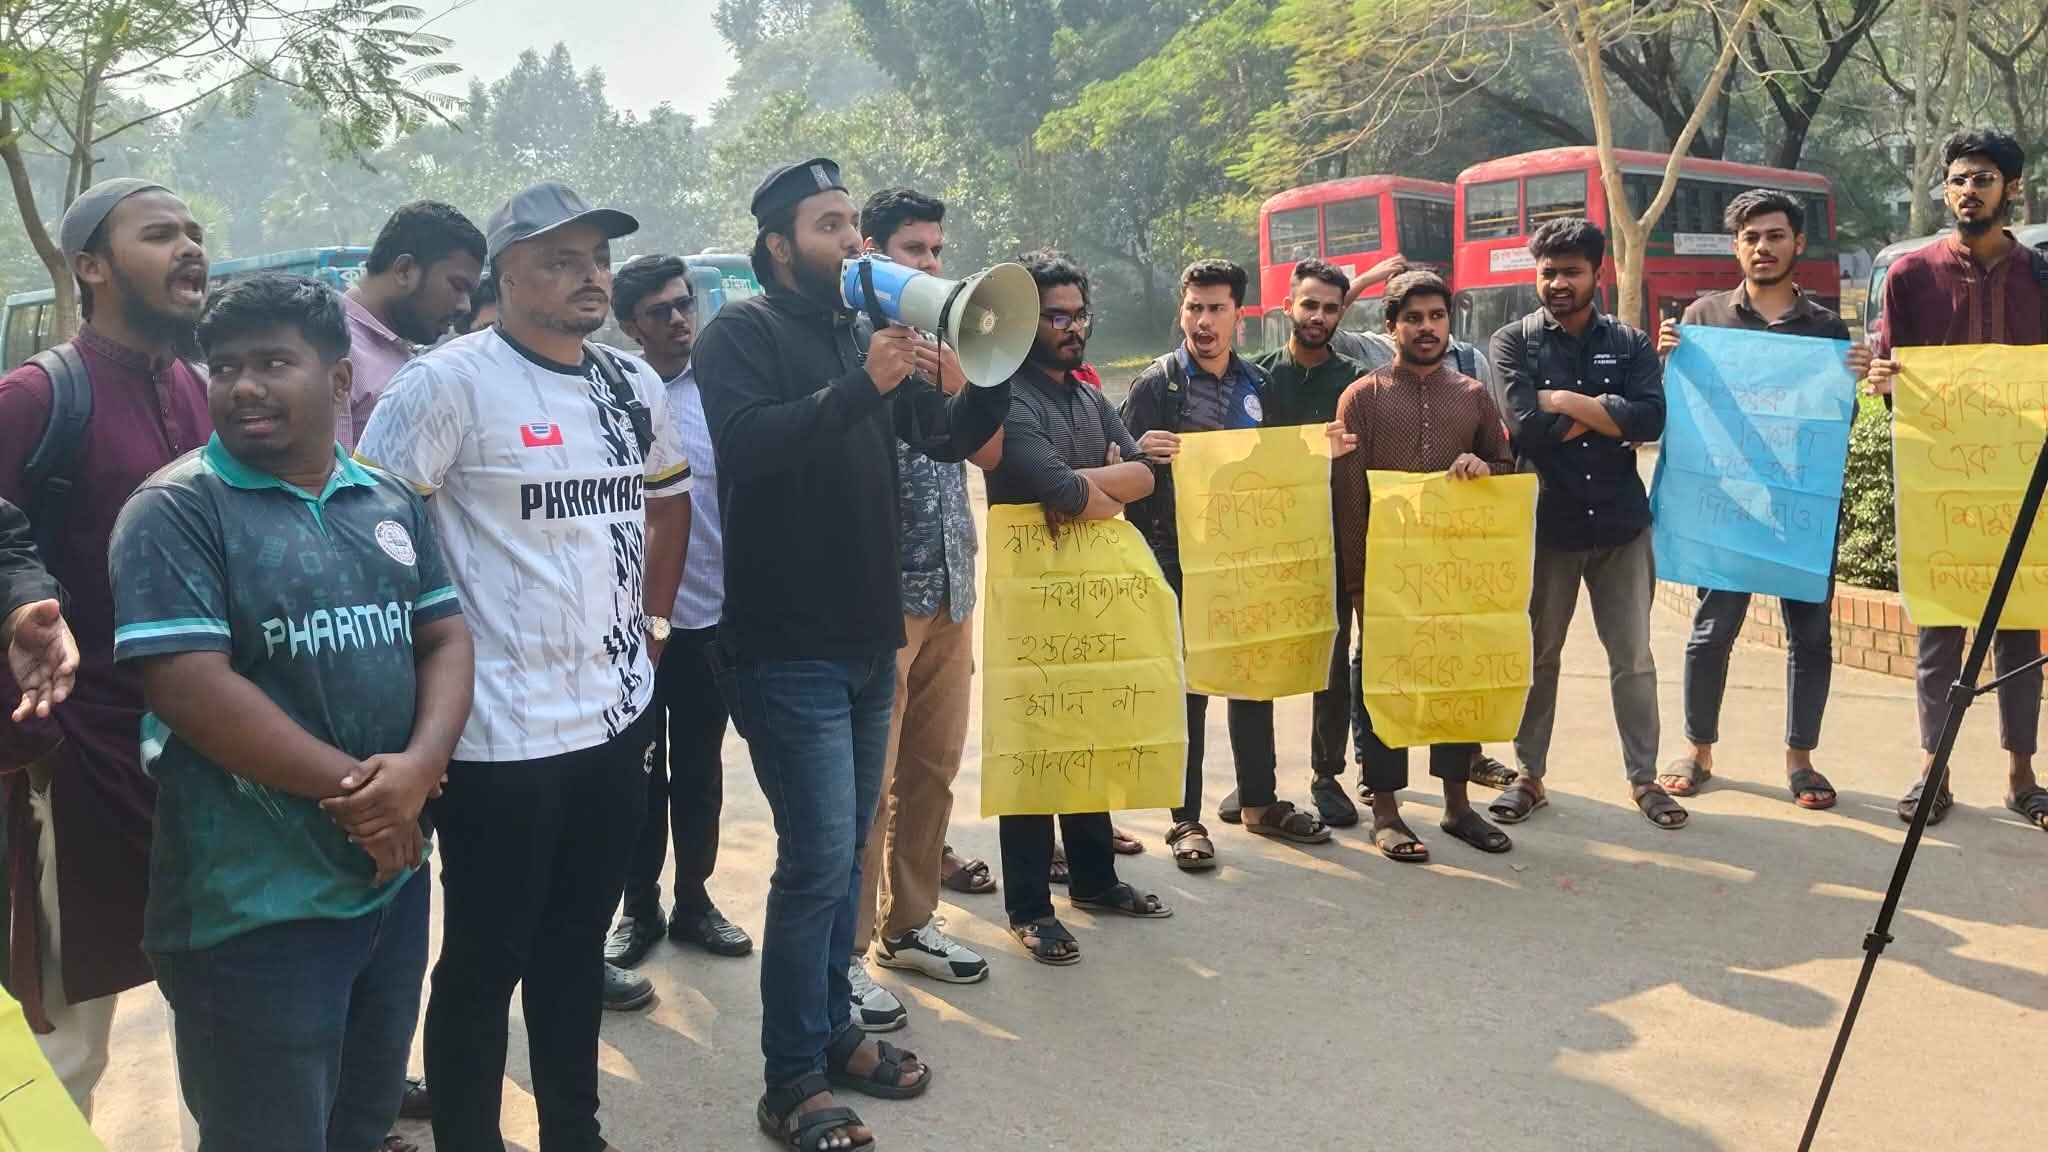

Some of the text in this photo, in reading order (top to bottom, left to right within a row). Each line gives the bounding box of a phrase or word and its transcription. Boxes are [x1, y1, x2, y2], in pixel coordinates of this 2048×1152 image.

[1928, 441, 2001, 480] এক
[520, 474, 643, 520] PHARMAC
[1004, 680, 1156, 720] মানি না
[1112, 744, 1158, 785] না
